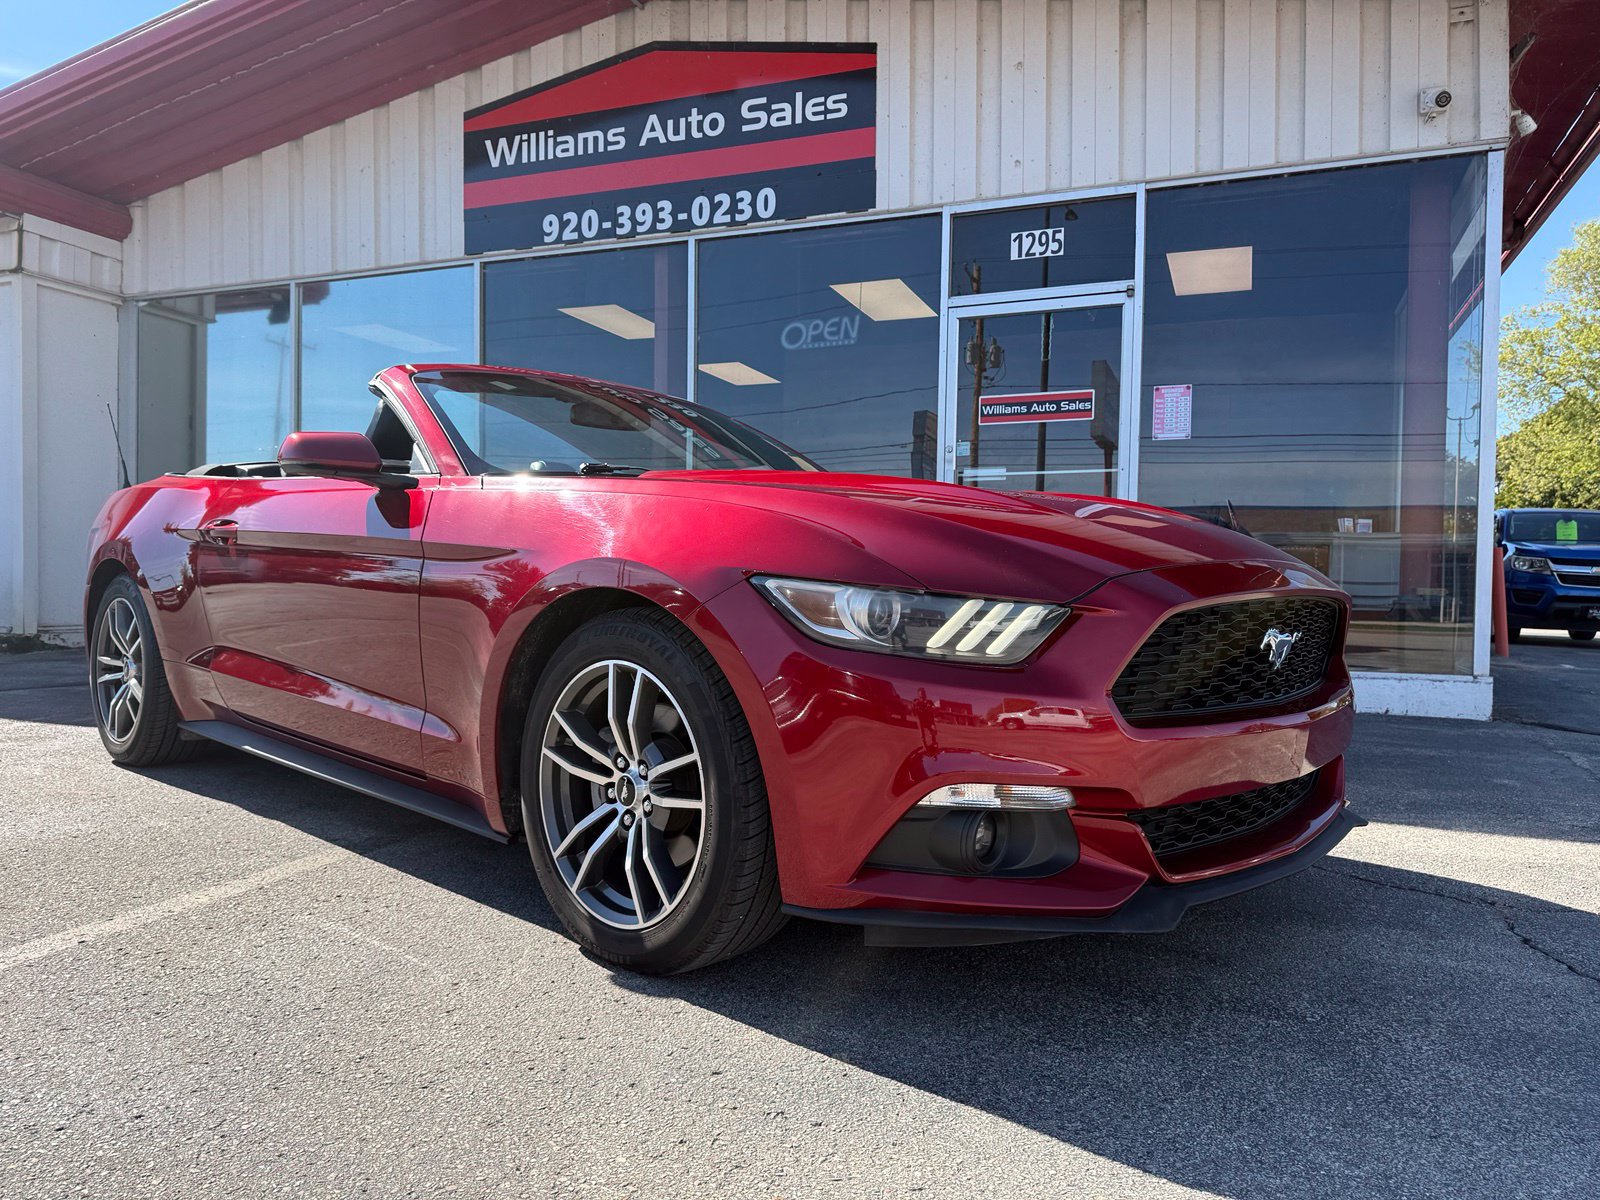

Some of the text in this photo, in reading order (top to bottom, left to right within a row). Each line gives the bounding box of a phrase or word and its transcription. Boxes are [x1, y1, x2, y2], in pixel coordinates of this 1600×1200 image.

[484, 91, 849, 167] Williams Auto Sales
[542, 187, 777, 243] 920-393-0230
[1012, 230, 1063, 258] 1295
[781, 315, 860, 350] OPEN
[982, 400, 1092, 415] Williams Auto Sales
